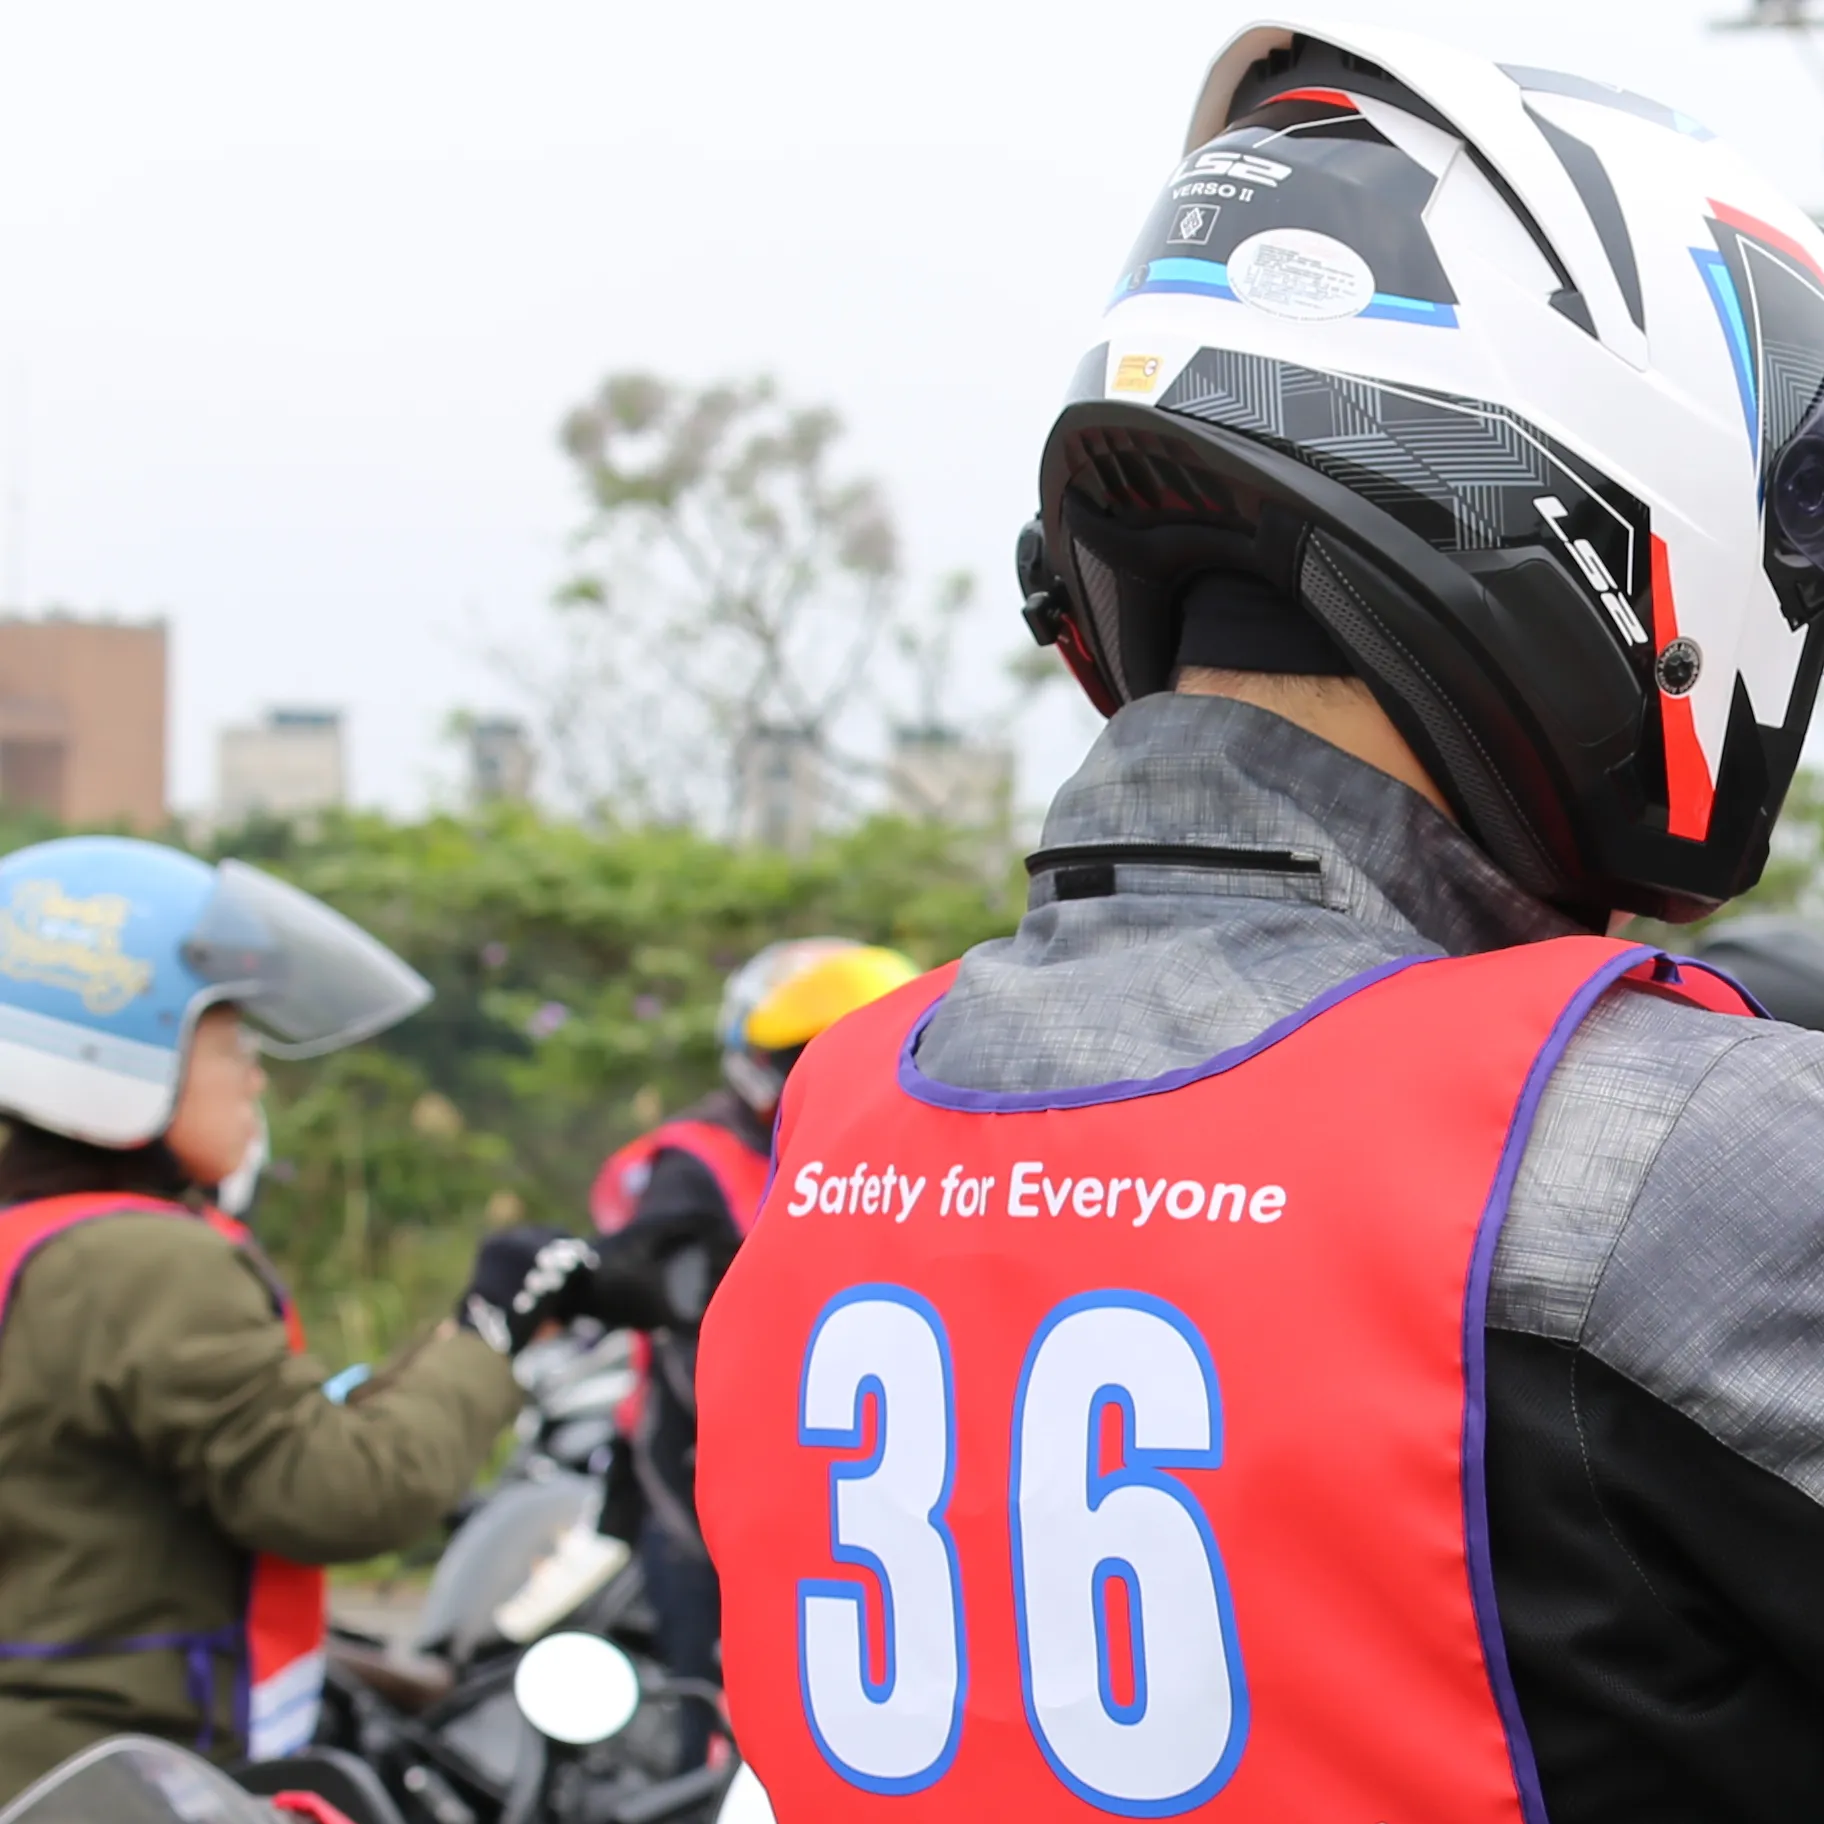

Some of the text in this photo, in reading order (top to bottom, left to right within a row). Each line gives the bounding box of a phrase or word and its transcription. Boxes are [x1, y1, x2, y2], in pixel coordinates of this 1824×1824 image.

[1168, 152, 1293, 187] LS2
[1172, 182, 1236, 200] VERSO
[1532, 496, 1649, 647] LS2
[787, 1161, 1287, 1227] Safety for Everyone
[797, 1283, 1250, 1818] 36
